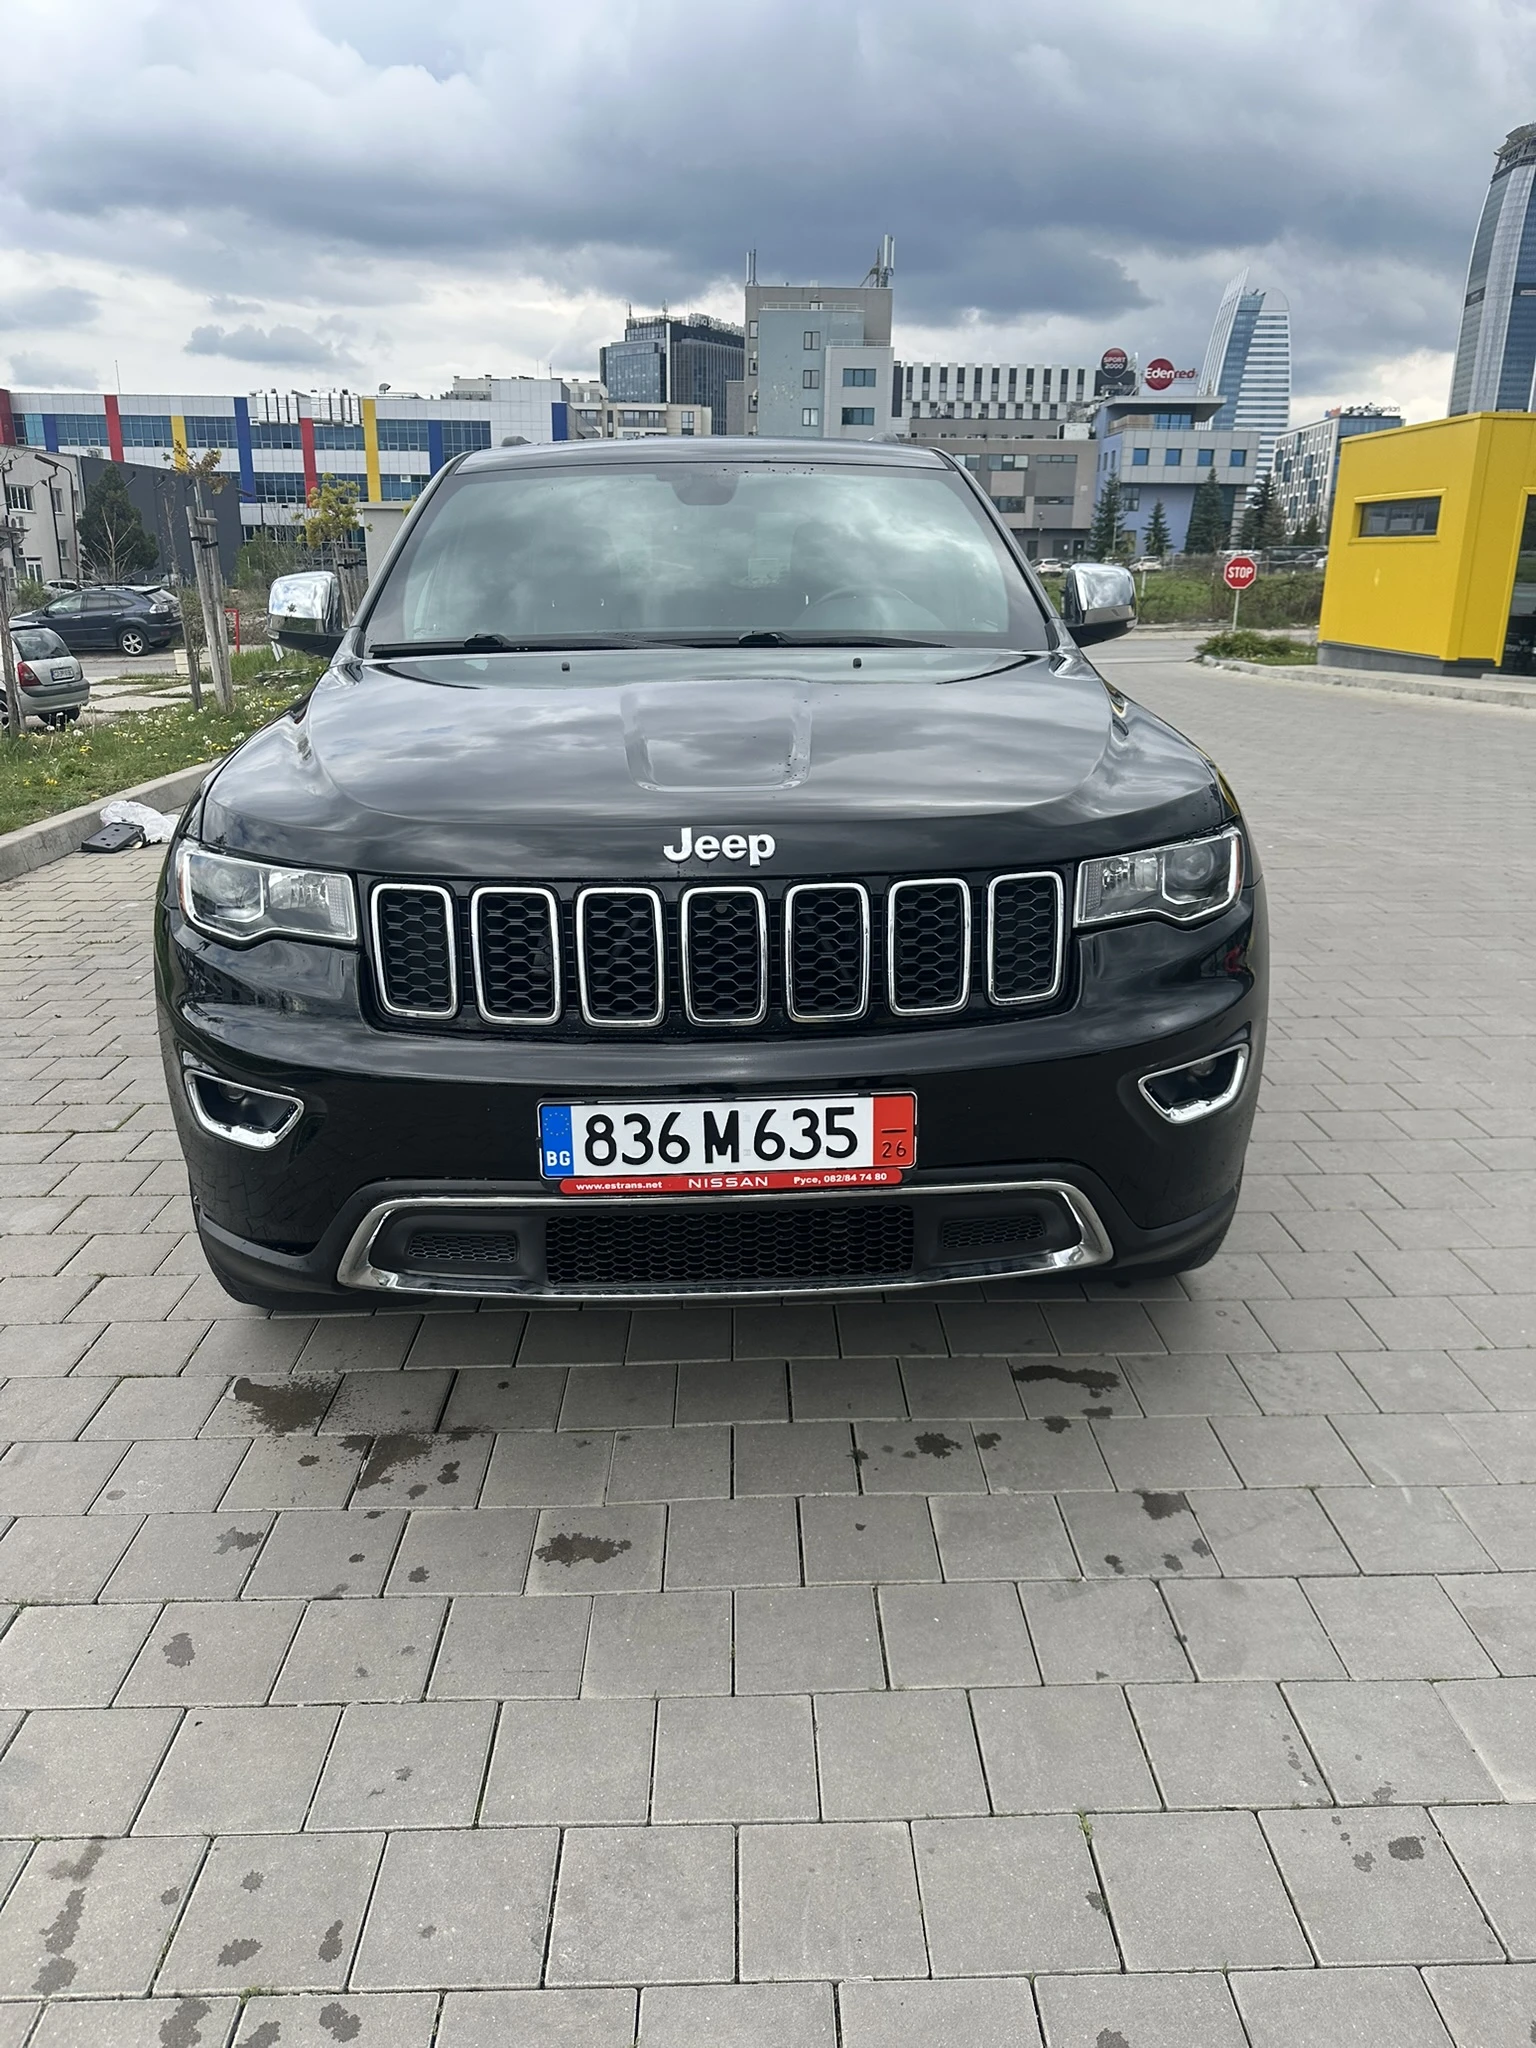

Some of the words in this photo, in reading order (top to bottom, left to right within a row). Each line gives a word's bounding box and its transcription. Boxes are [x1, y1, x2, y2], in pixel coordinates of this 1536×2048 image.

[1145, 367, 1196, 379] Edenred
[1227, 566, 1253, 578] STOP
[663, 827, 776, 867] Jeep
[584, 1112, 691, 1167] 836
[753, 1106, 858, 1162] 635
[881, 1140, 907, 1158] 26
[546, 1150, 571, 1167] BG
[688, 1176, 768, 1189] NISSAN
[823, 1173, 857, 1184] 082/84
[860, 1172, 872, 1182] 74
[874, 1171, 887, 1181] 80
[576, 1180, 663, 1191] www.estrans.net
